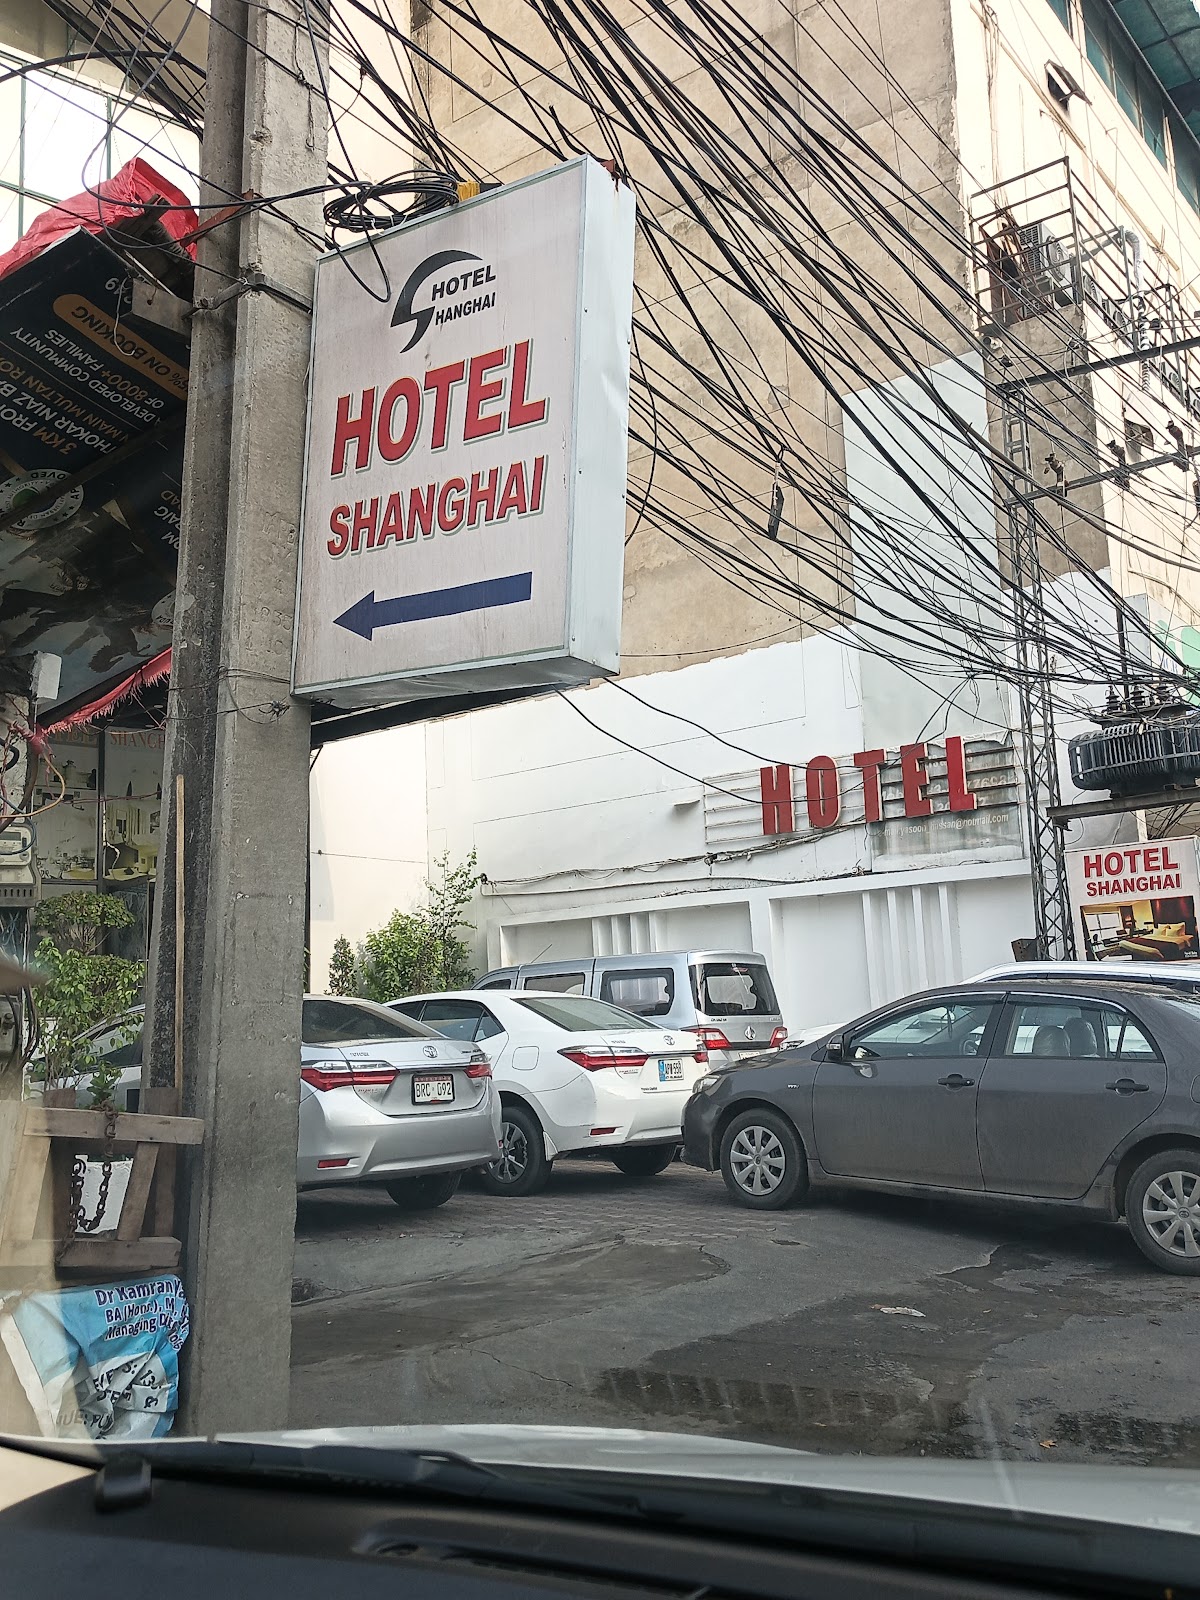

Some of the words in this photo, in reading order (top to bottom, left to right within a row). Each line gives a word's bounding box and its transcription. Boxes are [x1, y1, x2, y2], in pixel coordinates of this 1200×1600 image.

[431, 265, 496, 302] HOTEL
[71, 306, 144, 360] BOOKING
[10, 327, 90, 382] COMMUNITY
[44, 329, 104, 371] FAMILIES
[0, 358, 26, 380] RO
[144, 357, 171, 376] ON
[23, 378, 83, 418] MULTAN
[101, 370, 148, 400] 8000+
[14, 392, 57, 422] NIAZ
[88, 379, 156, 423] DEVELOPED
[144, 396, 165, 409] OF
[331, 338, 549, 479] HOTEL
[0, 403, 38, 432] FRO
[82, 413, 120, 439] MAIN
[33, 427, 63, 451] KM
[54, 417, 117, 454] THOKAR
[161, 490, 181, 510] AD
[327, 455, 549, 559] SHANGHAI
[760, 736, 977, 836] HOTEL
[1083, 846, 1180, 879] HOTEL
[1086, 873, 1182, 897] SHANGHAI
[415, 1083, 431, 1098] BRC
[95, 1290, 114, 1306] Dr
[115, 1281, 173, 1301] Kamran
[105, 1307, 122, 1323] BA
[105, 1317, 157, 1340] Managing
